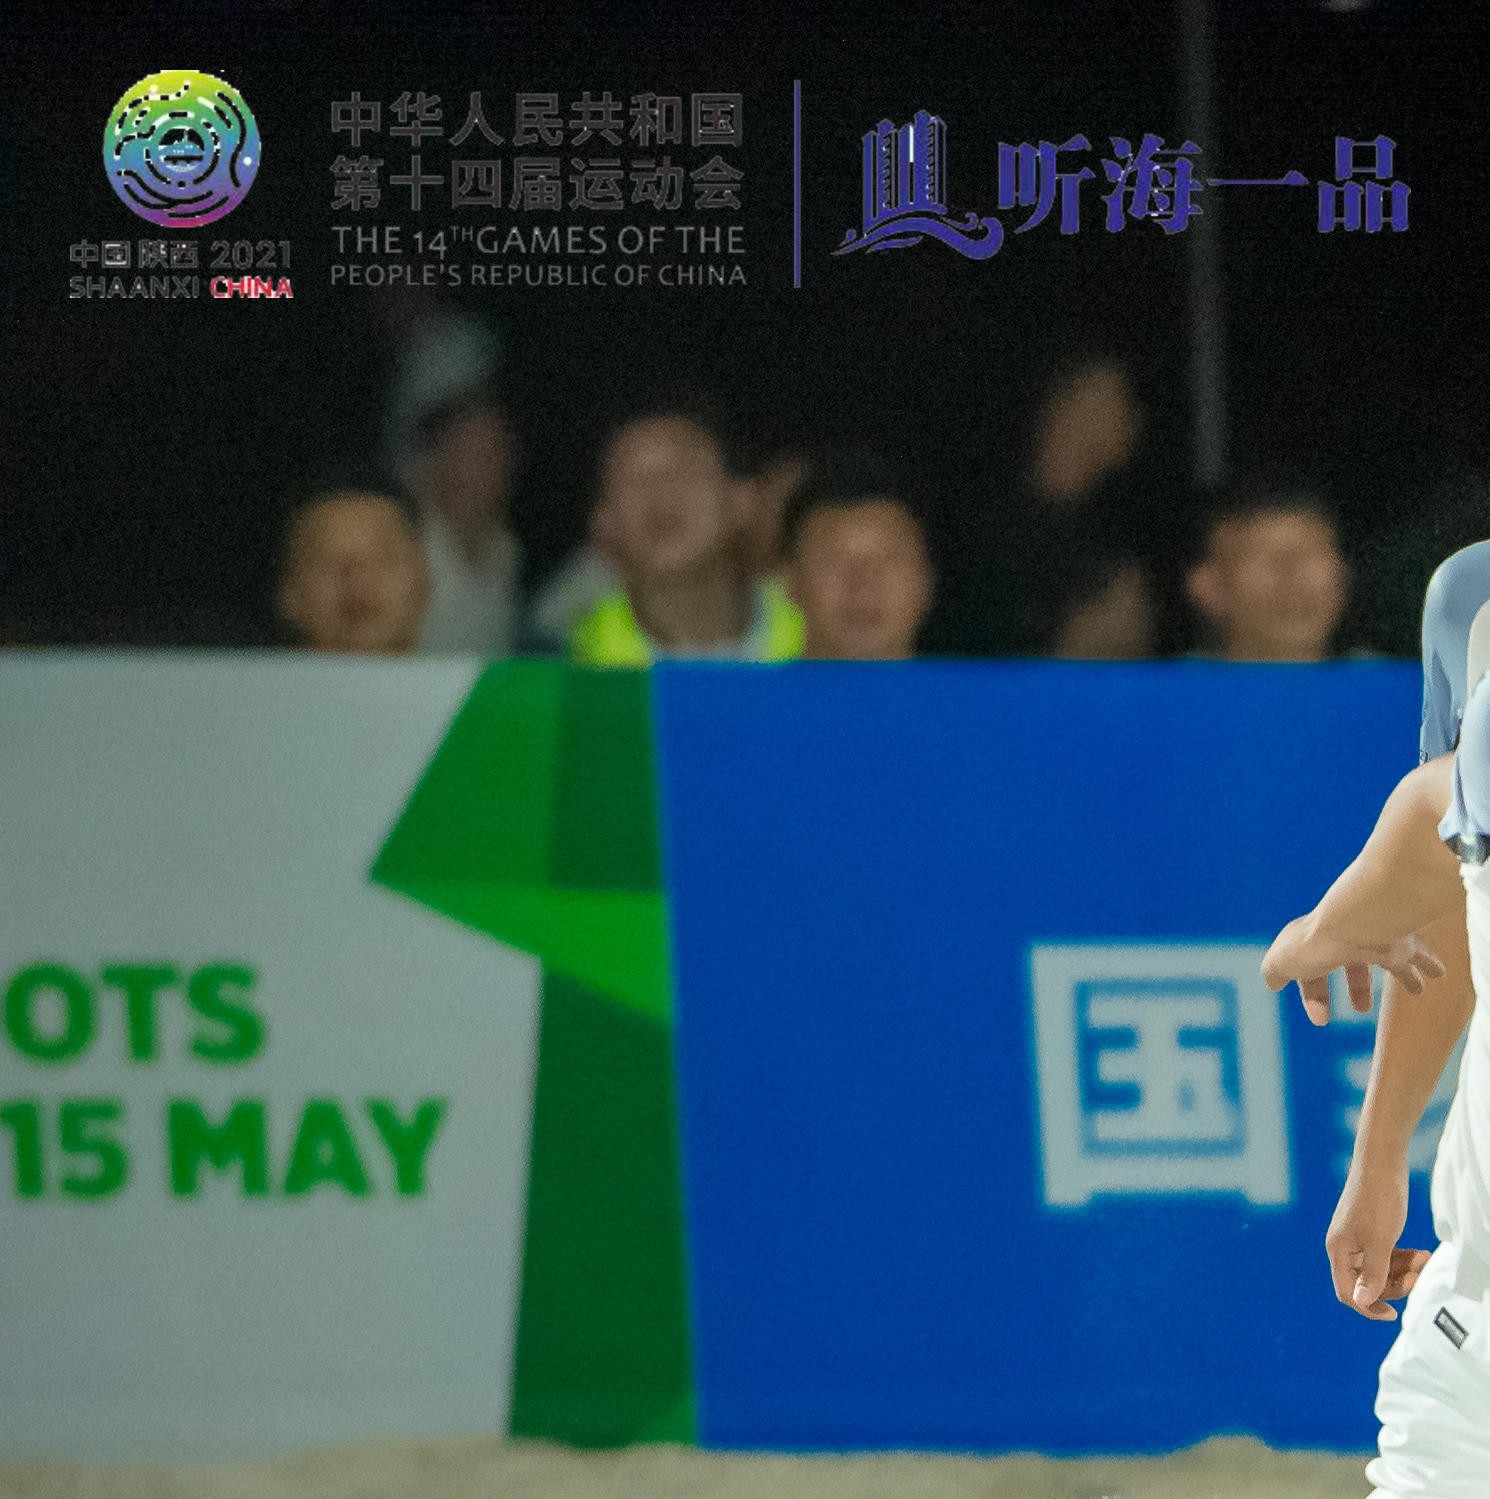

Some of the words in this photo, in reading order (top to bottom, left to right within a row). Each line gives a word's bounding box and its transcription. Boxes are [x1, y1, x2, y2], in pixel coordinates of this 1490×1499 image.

[2, 960, 267, 1064] OTS
[0, 1099, 129, 1198] 15
[168, 1098, 447, 1199] MAY
